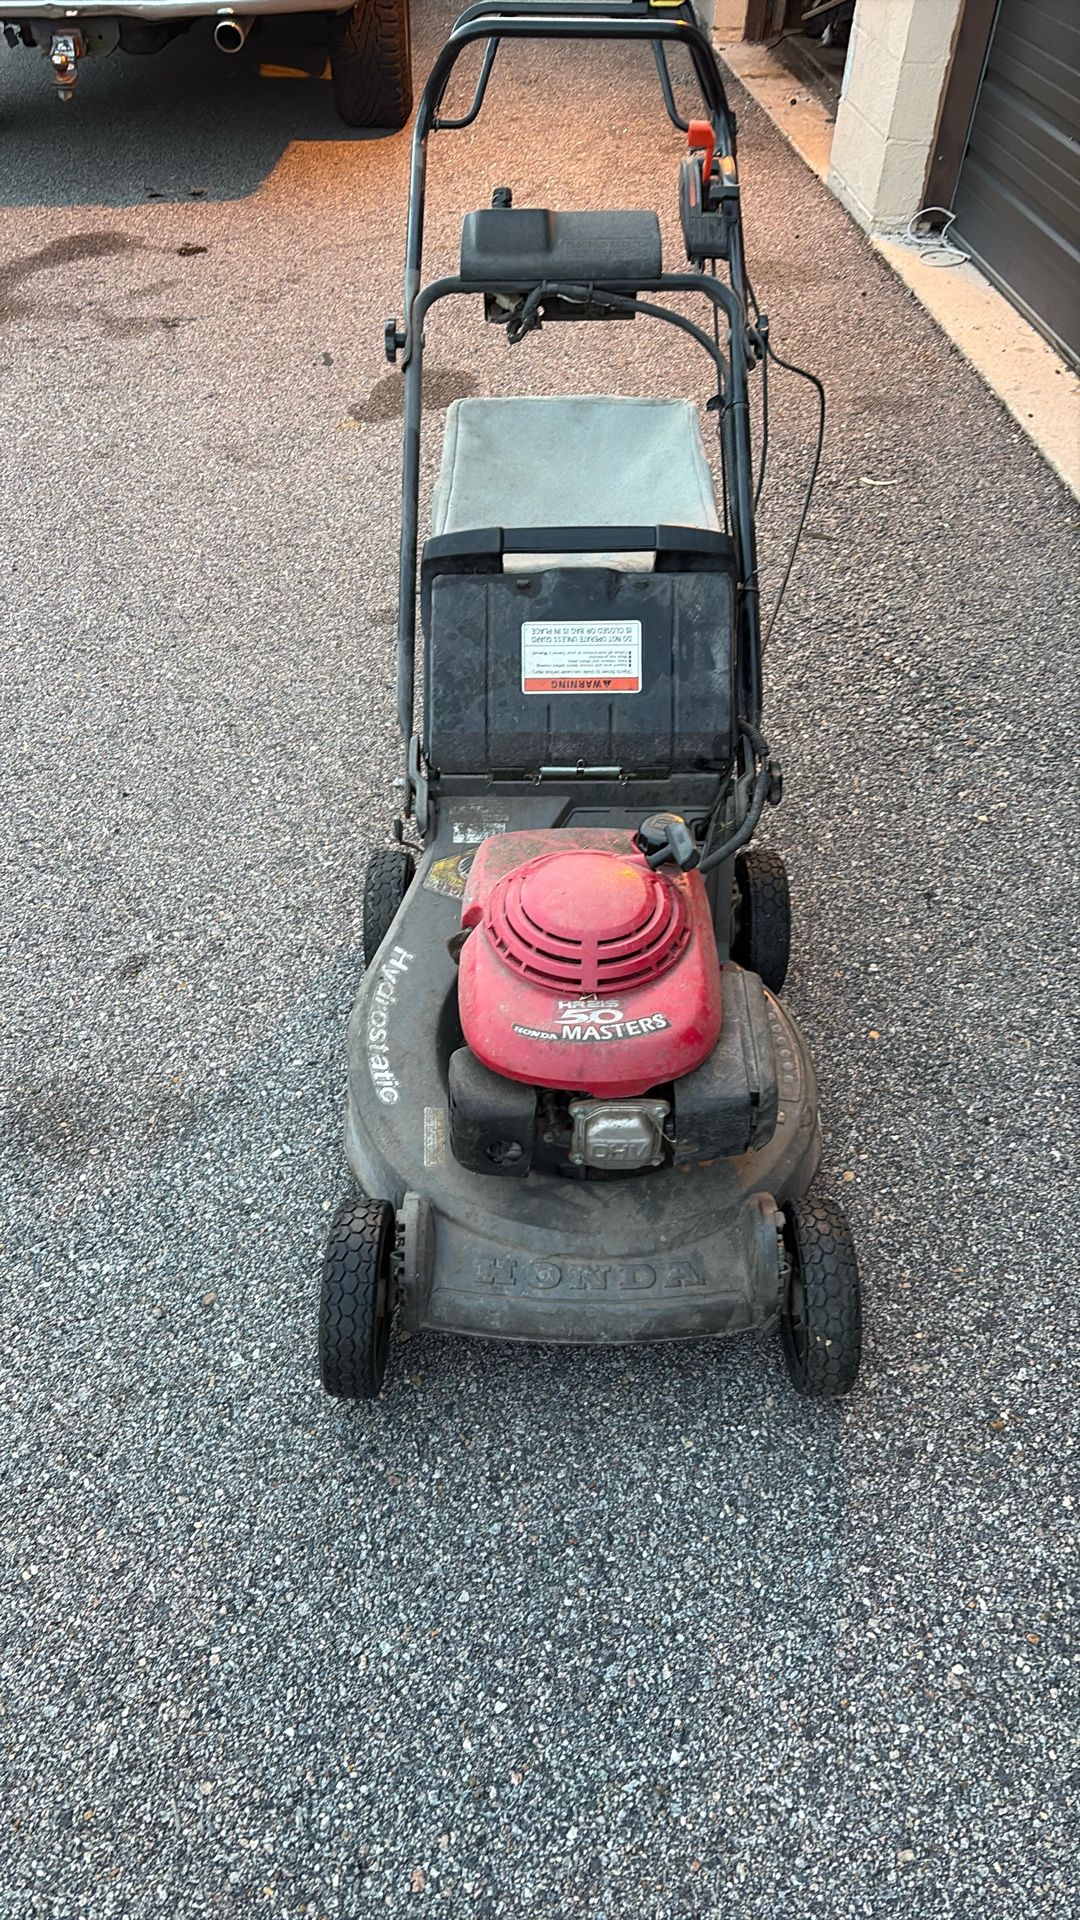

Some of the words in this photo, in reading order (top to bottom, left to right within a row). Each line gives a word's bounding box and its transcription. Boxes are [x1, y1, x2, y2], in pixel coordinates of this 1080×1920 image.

[551, 680, 601, 689] WARNING
[368, 945, 413, 1104] Hydrostatic
[514, 1025, 559, 1040] HONDA
[562, 1013, 668, 1040] MASTERS
[553, 1009, 624, 1024] 50
[591, 1142, 648, 1160] OHV
[473, 1258, 706, 1289] HONDA
